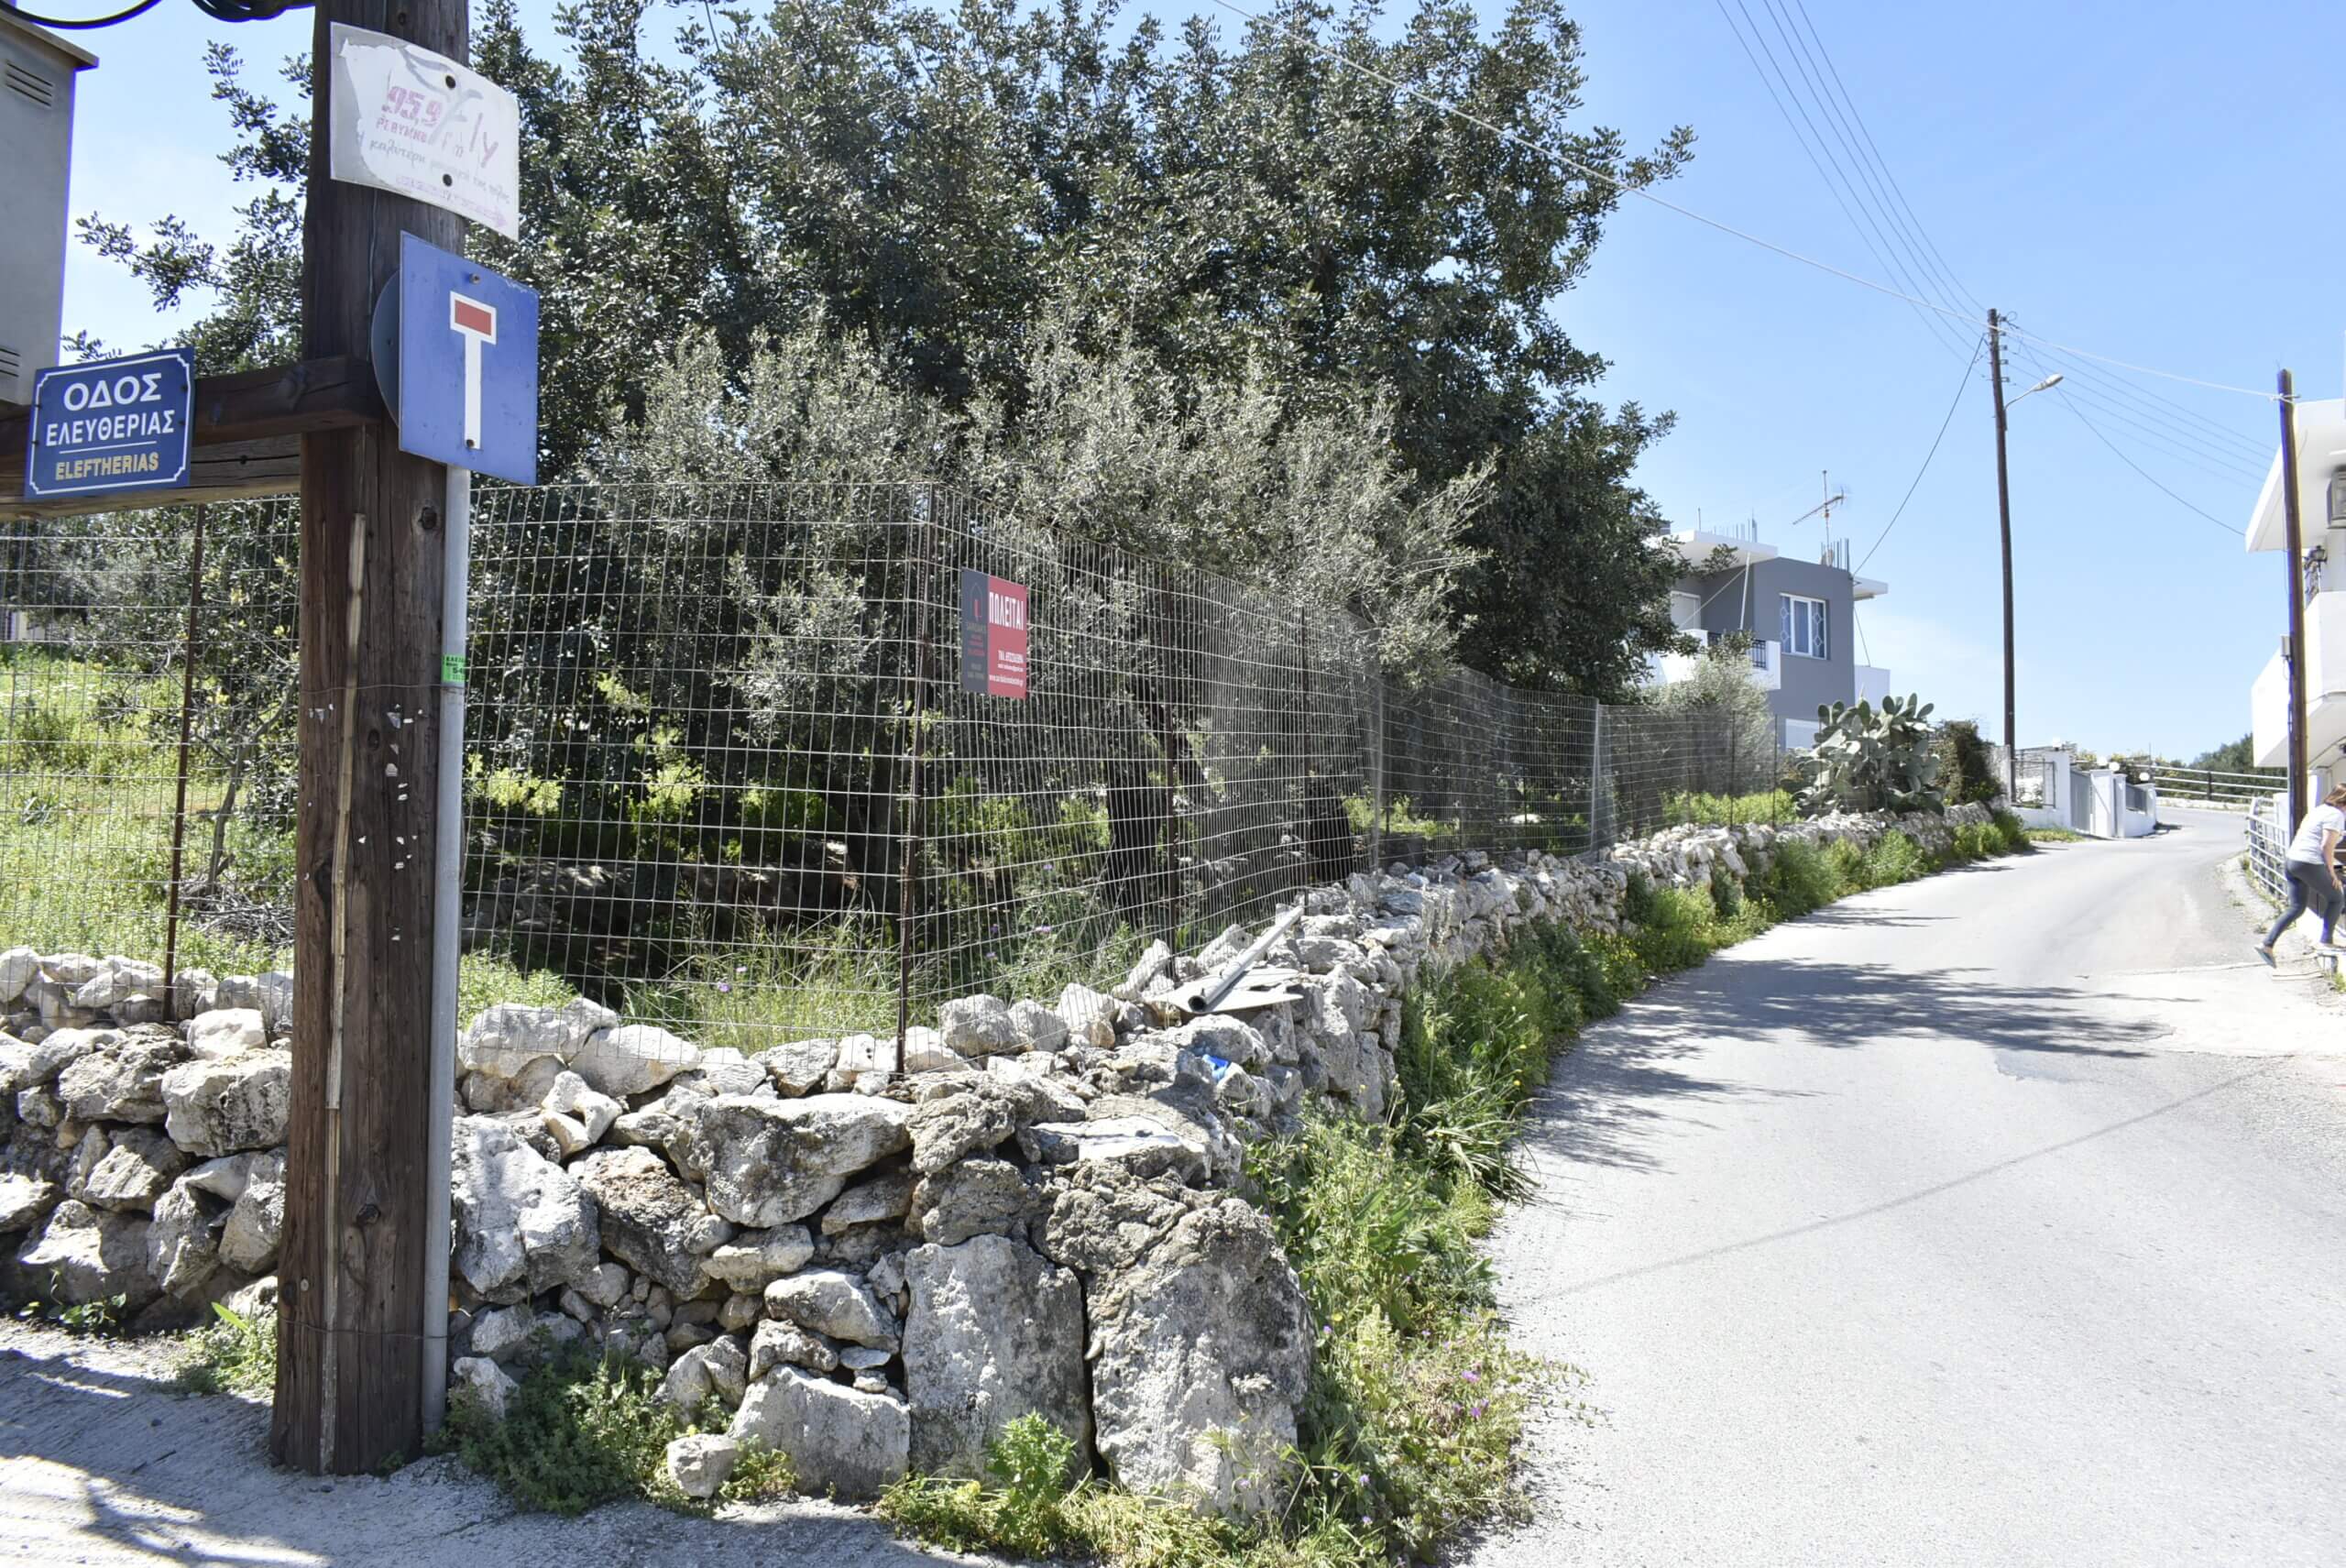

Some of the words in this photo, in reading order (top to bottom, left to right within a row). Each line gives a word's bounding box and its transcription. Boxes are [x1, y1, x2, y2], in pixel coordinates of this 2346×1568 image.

[63, 372, 162, 411] ΟΔΟΣ
[46, 409, 175, 446] ΕΛΕΥΘΕΡΙΑΣ
[55, 452, 159, 481] ELEFTHERIAS
